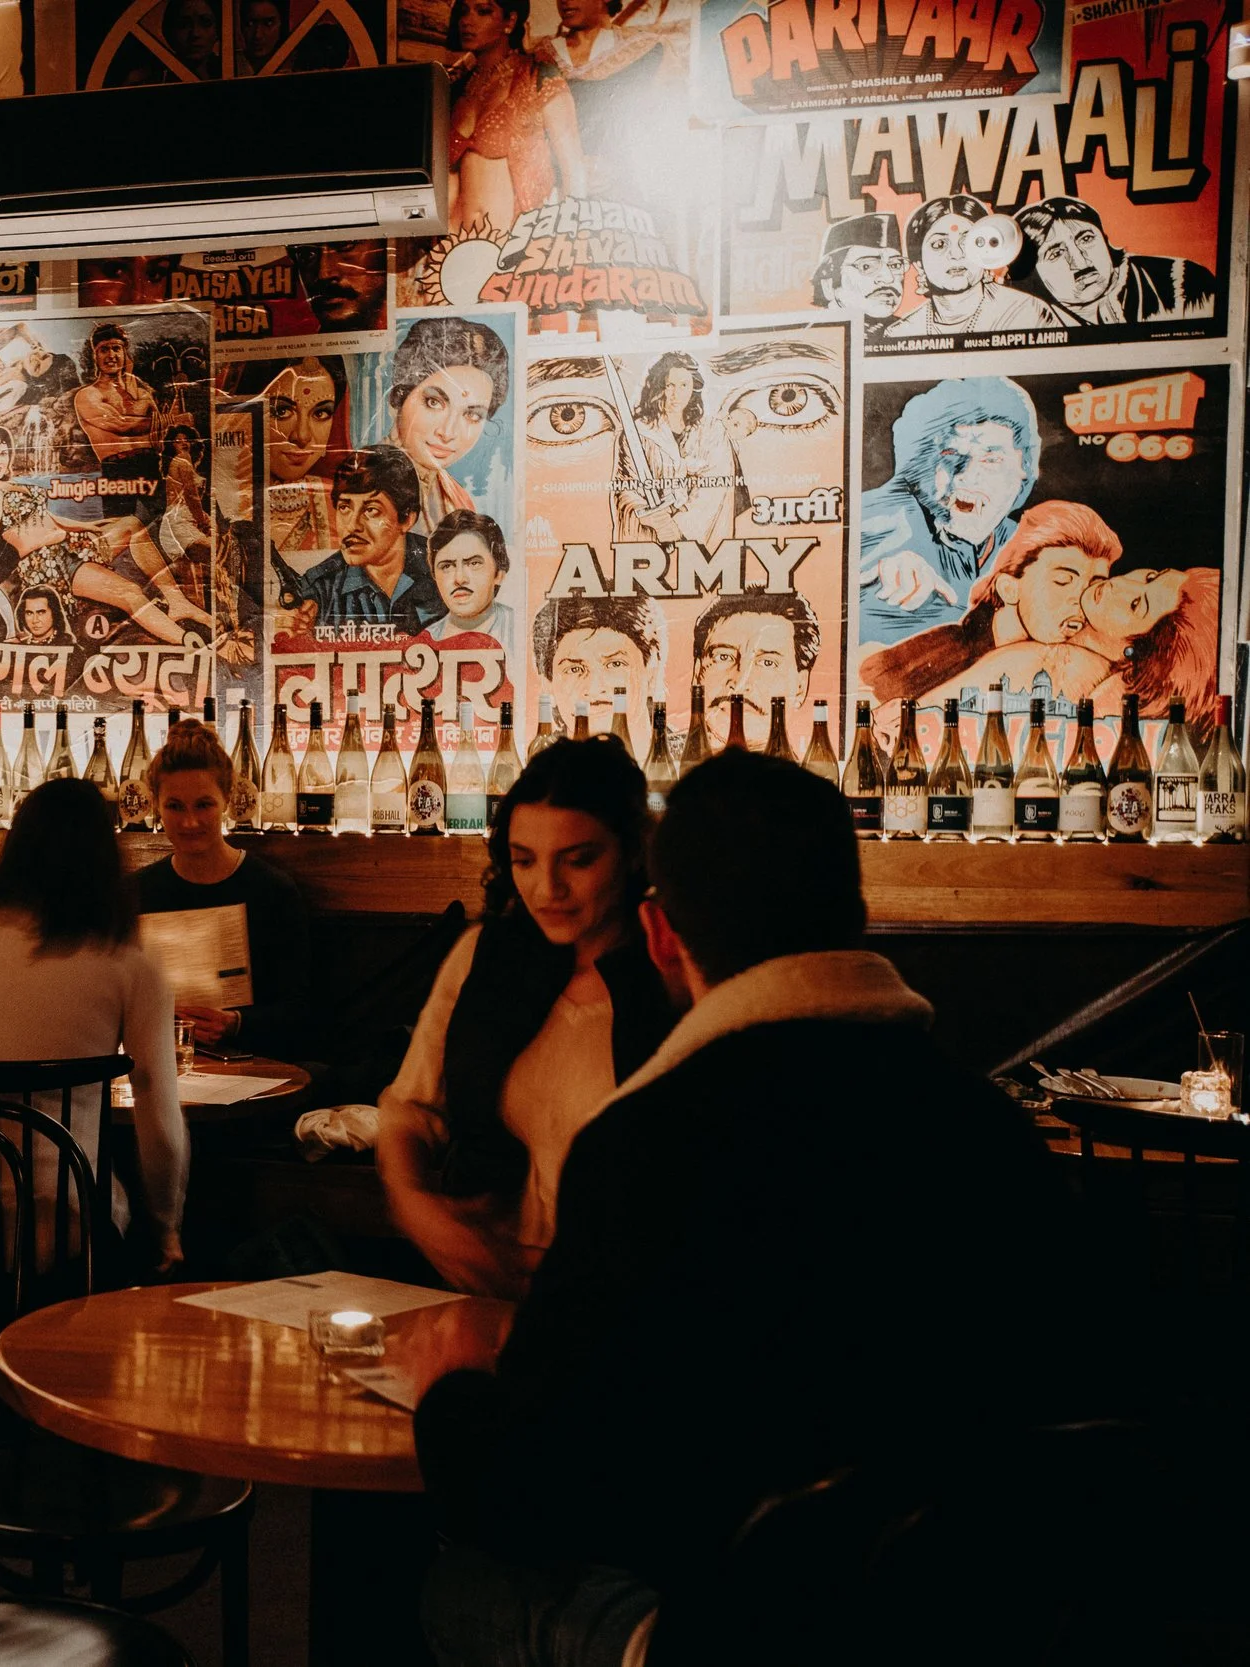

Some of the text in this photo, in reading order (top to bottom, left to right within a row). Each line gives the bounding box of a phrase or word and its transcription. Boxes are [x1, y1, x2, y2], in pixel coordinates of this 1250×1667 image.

[851, 76, 913, 89] SHASHILAL
[915, 74, 944, 84] NAIR
[791, 97, 848, 109] LAXMIKANT
[850, 94, 899, 105] PYARELAL
[926, 89, 962, 99] ANAND
[964, 86, 1003, 97] BAKSHI
[242, 265, 291, 295] YEH
[964, 339, 990, 349] MUSIC
[991, 334, 1026, 347] BAPPI
[1063, 371, 1195, 430] बंगला
[1078, 433, 1194, 463] NO 666
[48, 477, 158, 502] Jungle Beauty
[607, 480, 639, 492] KHAN
[643, 477, 691, 491] SRIDEVI
[698, 475, 734, 488] KIRAN
[546, 538, 819, 599] ARMY
[91, 617, 105, 635] A
[1204, 792, 1237, 804] YARRA
[1204, 803, 1237, 815] PEAKS
